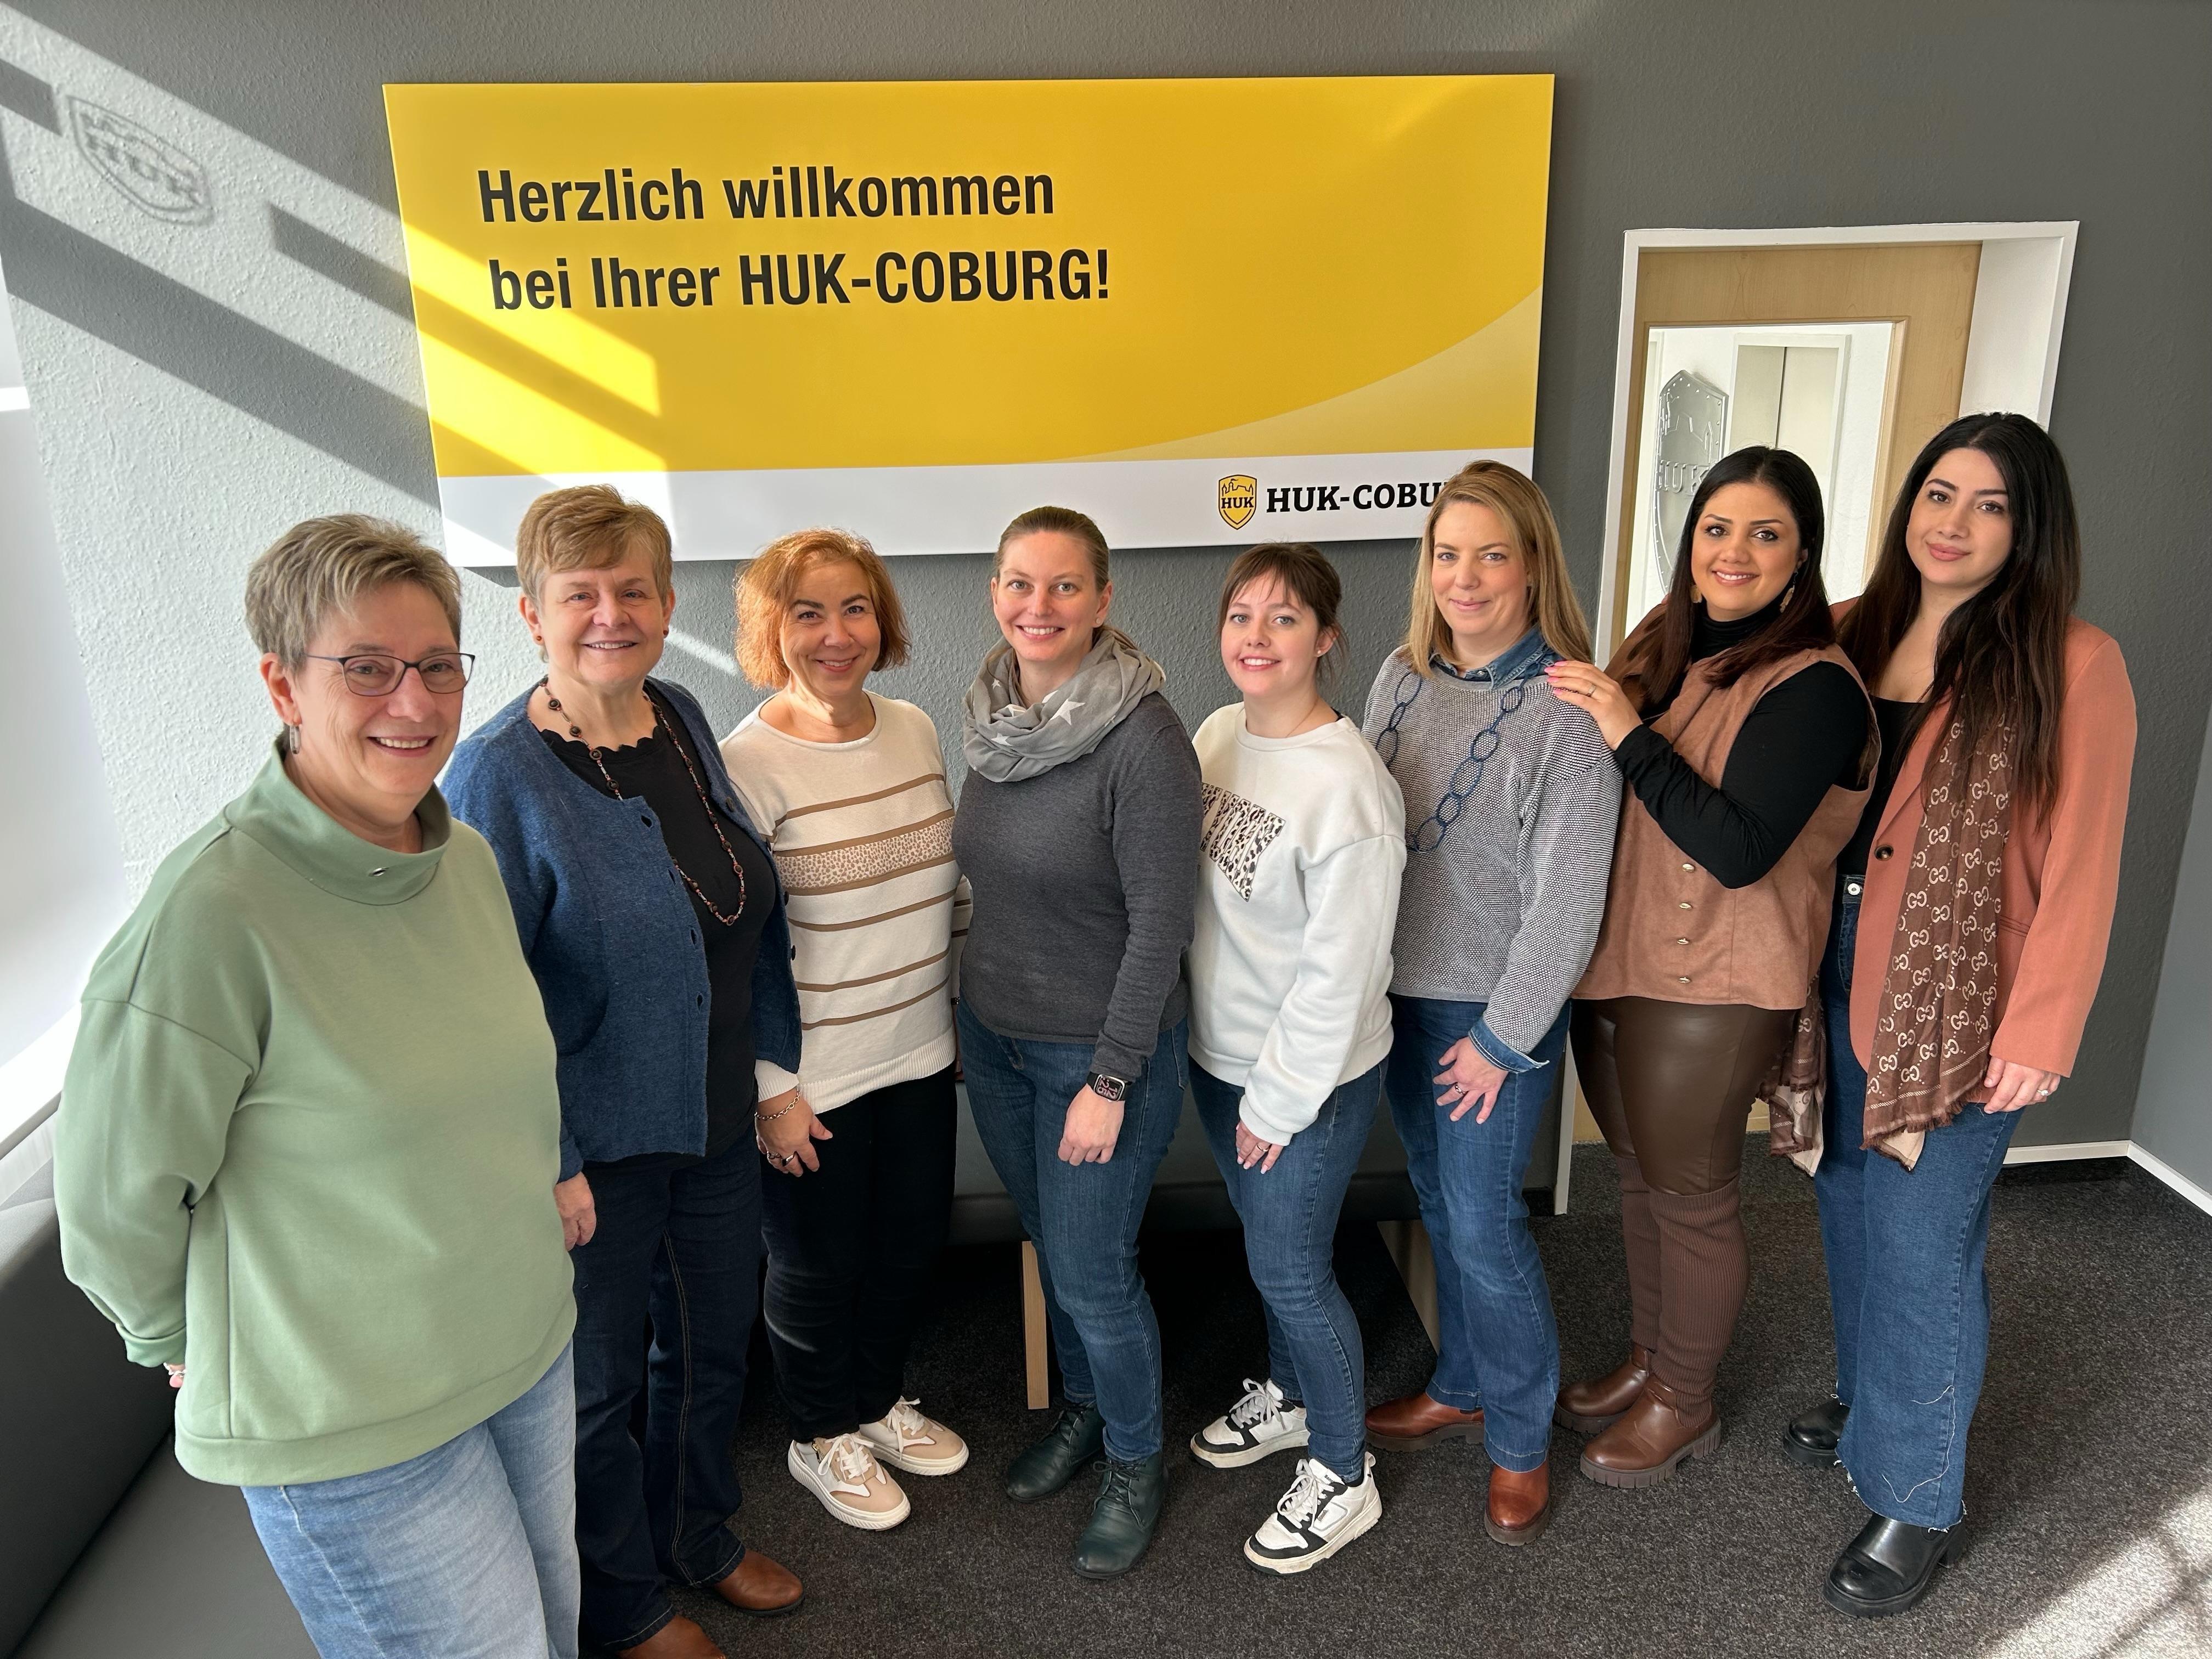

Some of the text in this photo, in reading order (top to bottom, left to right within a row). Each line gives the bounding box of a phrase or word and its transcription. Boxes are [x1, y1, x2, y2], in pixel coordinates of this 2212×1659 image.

[477, 166, 1054, 223] Herzlich willkommen
[488, 249, 1109, 310] bei Ihrer HUK-COBURG!
[1221, 496, 1254, 509] HUK
[1266, 482, 1447, 513] HUK-COBU
